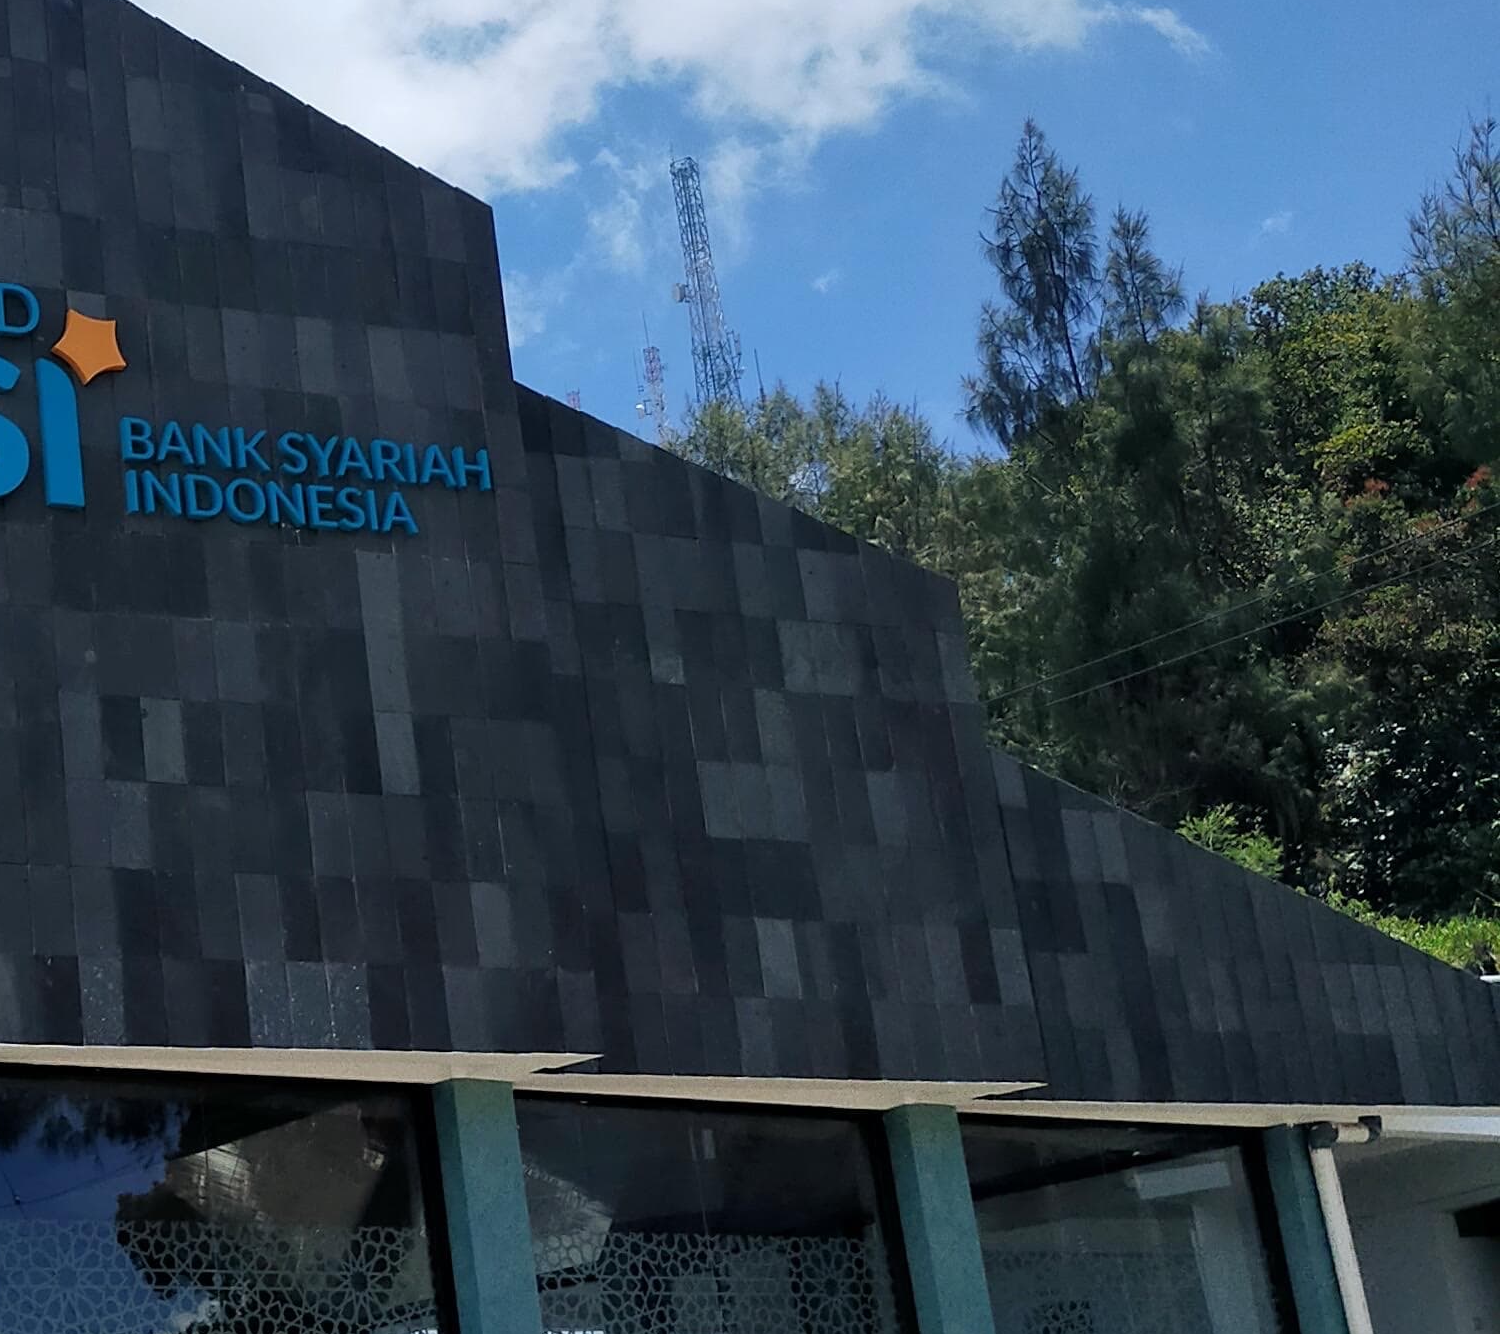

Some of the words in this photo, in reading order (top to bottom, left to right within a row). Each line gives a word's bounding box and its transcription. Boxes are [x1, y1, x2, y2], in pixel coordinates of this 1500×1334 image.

[119, 414, 271, 473] BANK
[276, 429, 493, 493] SYARIAH
[124, 469, 420, 536] INDONESIA
